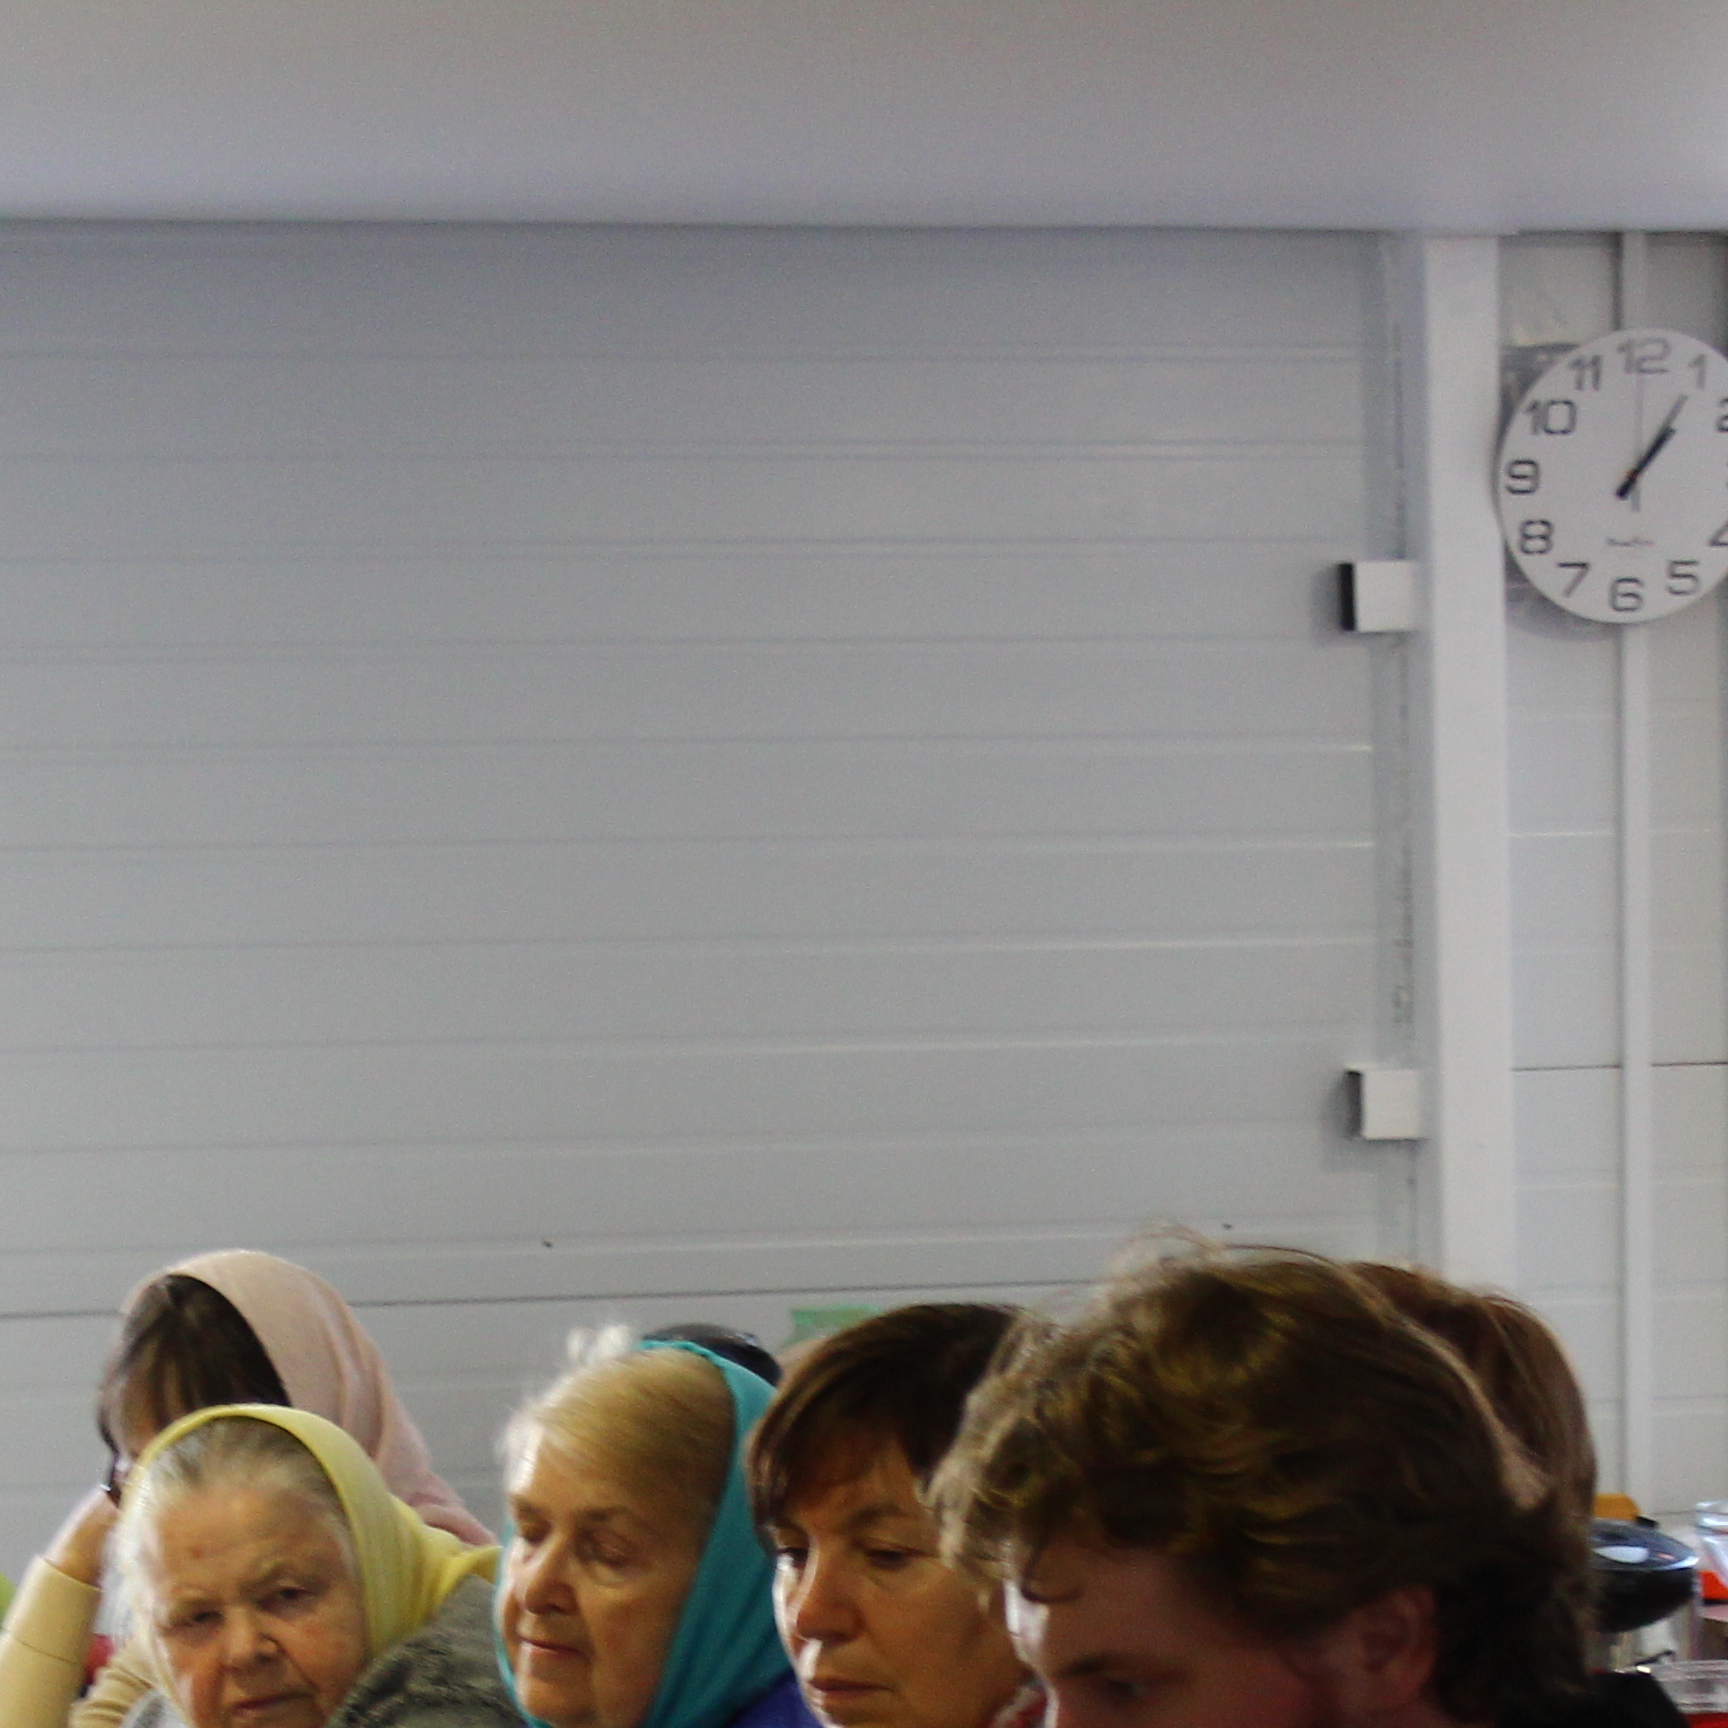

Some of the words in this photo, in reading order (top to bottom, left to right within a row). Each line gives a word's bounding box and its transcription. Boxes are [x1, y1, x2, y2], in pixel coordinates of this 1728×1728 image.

[1569, 354, 1603, 392] 11
[1616, 336, 1671, 375] 12
[1688, 354, 1709, 390] 1
[1524, 398, 1577, 436] 10
[1505, 458, 1540, 495] 9
[1519, 519, 1554, 555] 8
[1556, 560, 1591, 598] 7
[1609, 577, 1644, 612] 6
[1667, 559, 1700, 595] 5
